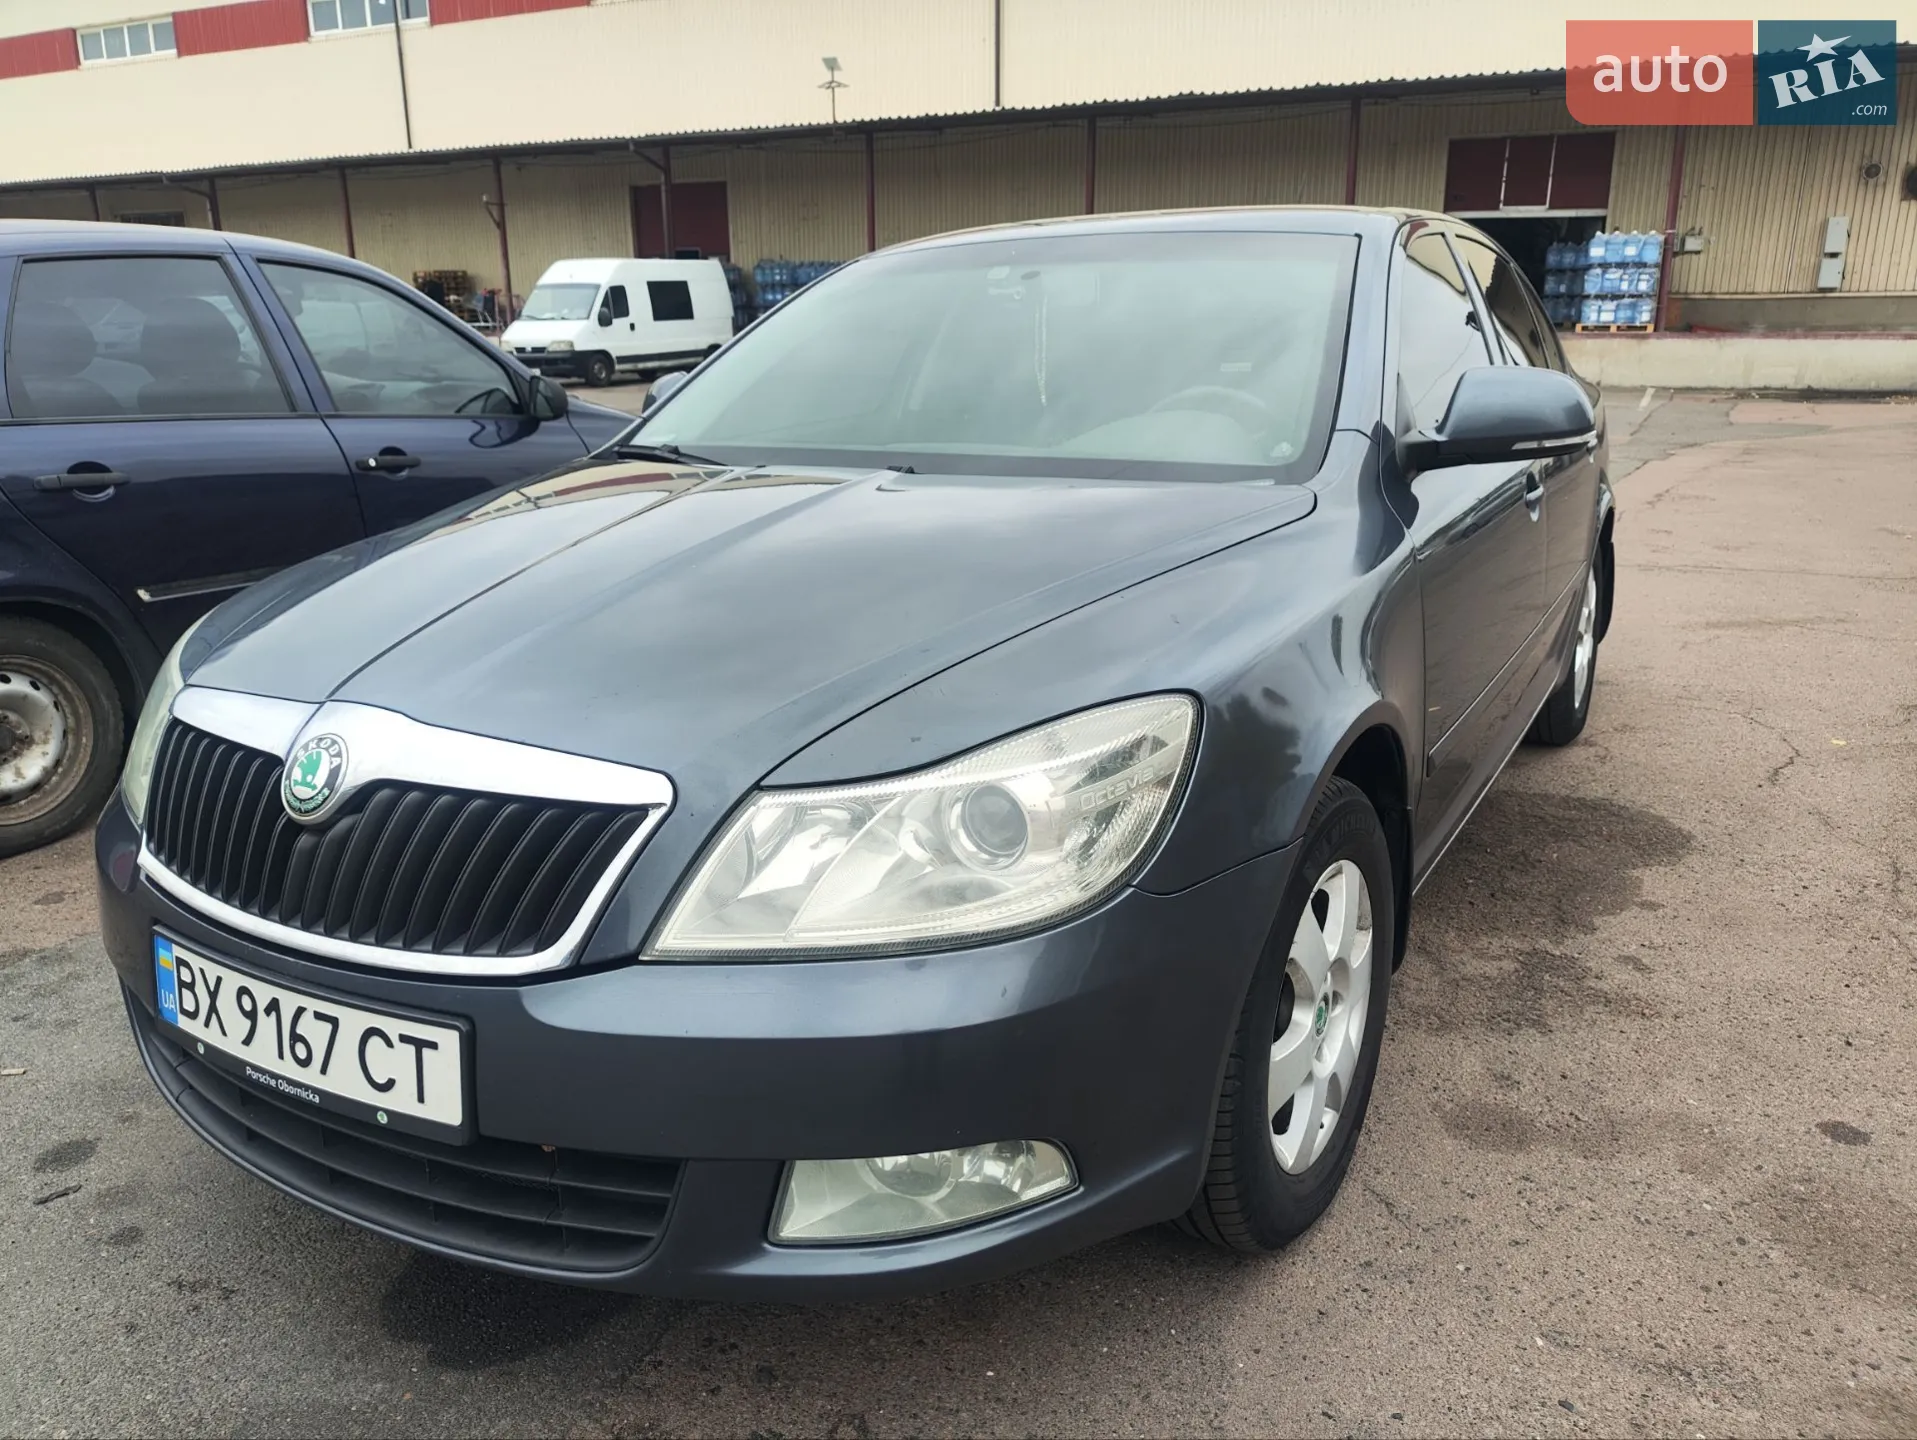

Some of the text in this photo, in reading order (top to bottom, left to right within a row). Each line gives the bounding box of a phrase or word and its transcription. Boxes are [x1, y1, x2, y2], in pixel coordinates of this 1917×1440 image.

[161, 988, 177, 1013] UA
[174, 955, 439, 1104] BX 9167 CT
[245, 1065, 320, 1104] Porsche Obornicka
